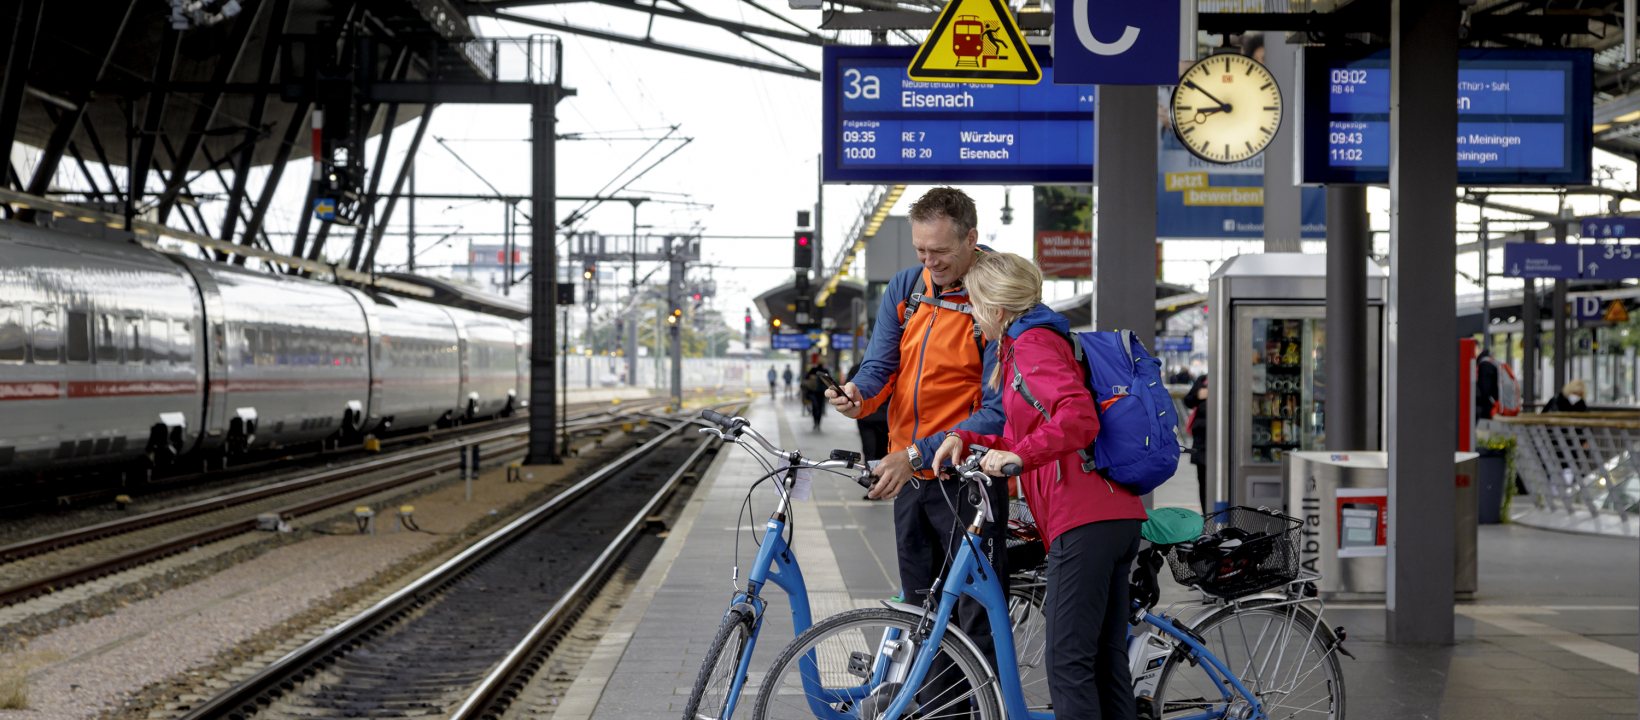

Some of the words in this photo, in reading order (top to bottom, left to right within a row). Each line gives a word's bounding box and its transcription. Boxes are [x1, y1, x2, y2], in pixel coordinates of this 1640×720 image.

[1073, 0, 1140, 56] C
[844, 69, 880, 99] 3a
[1332, 70, 1367, 84] 09:02
[1332, 85, 1342, 94] RB
[1344, 85, 1355, 94] 44
[1491, 82, 1510, 91] Suhl
[902, 91, 974, 107] Eisenach
[843, 131, 876, 142] 09:35
[902, 132, 915, 142] RE
[919, 132, 926, 142] 7
[960, 131, 1014, 145] Würzburg
[1330, 132, 1363, 144] 09:43
[1469, 134, 1521, 147] Meiningen
[844, 147, 876, 159] 10:00
[902, 148, 916, 158] RB
[919, 148, 933, 158] 20
[960, 148, 1009, 159] Eisenach
[1331, 148, 1363, 160] 11:02
[1457, 151, 1498, 164] einingen
[1170, 174, 1204, 188] Jetzt
[1072, 236, 1085, 246] du
[1583, 297, 1600, 316] D
[1302, 498, 1320, 574] Abfall
